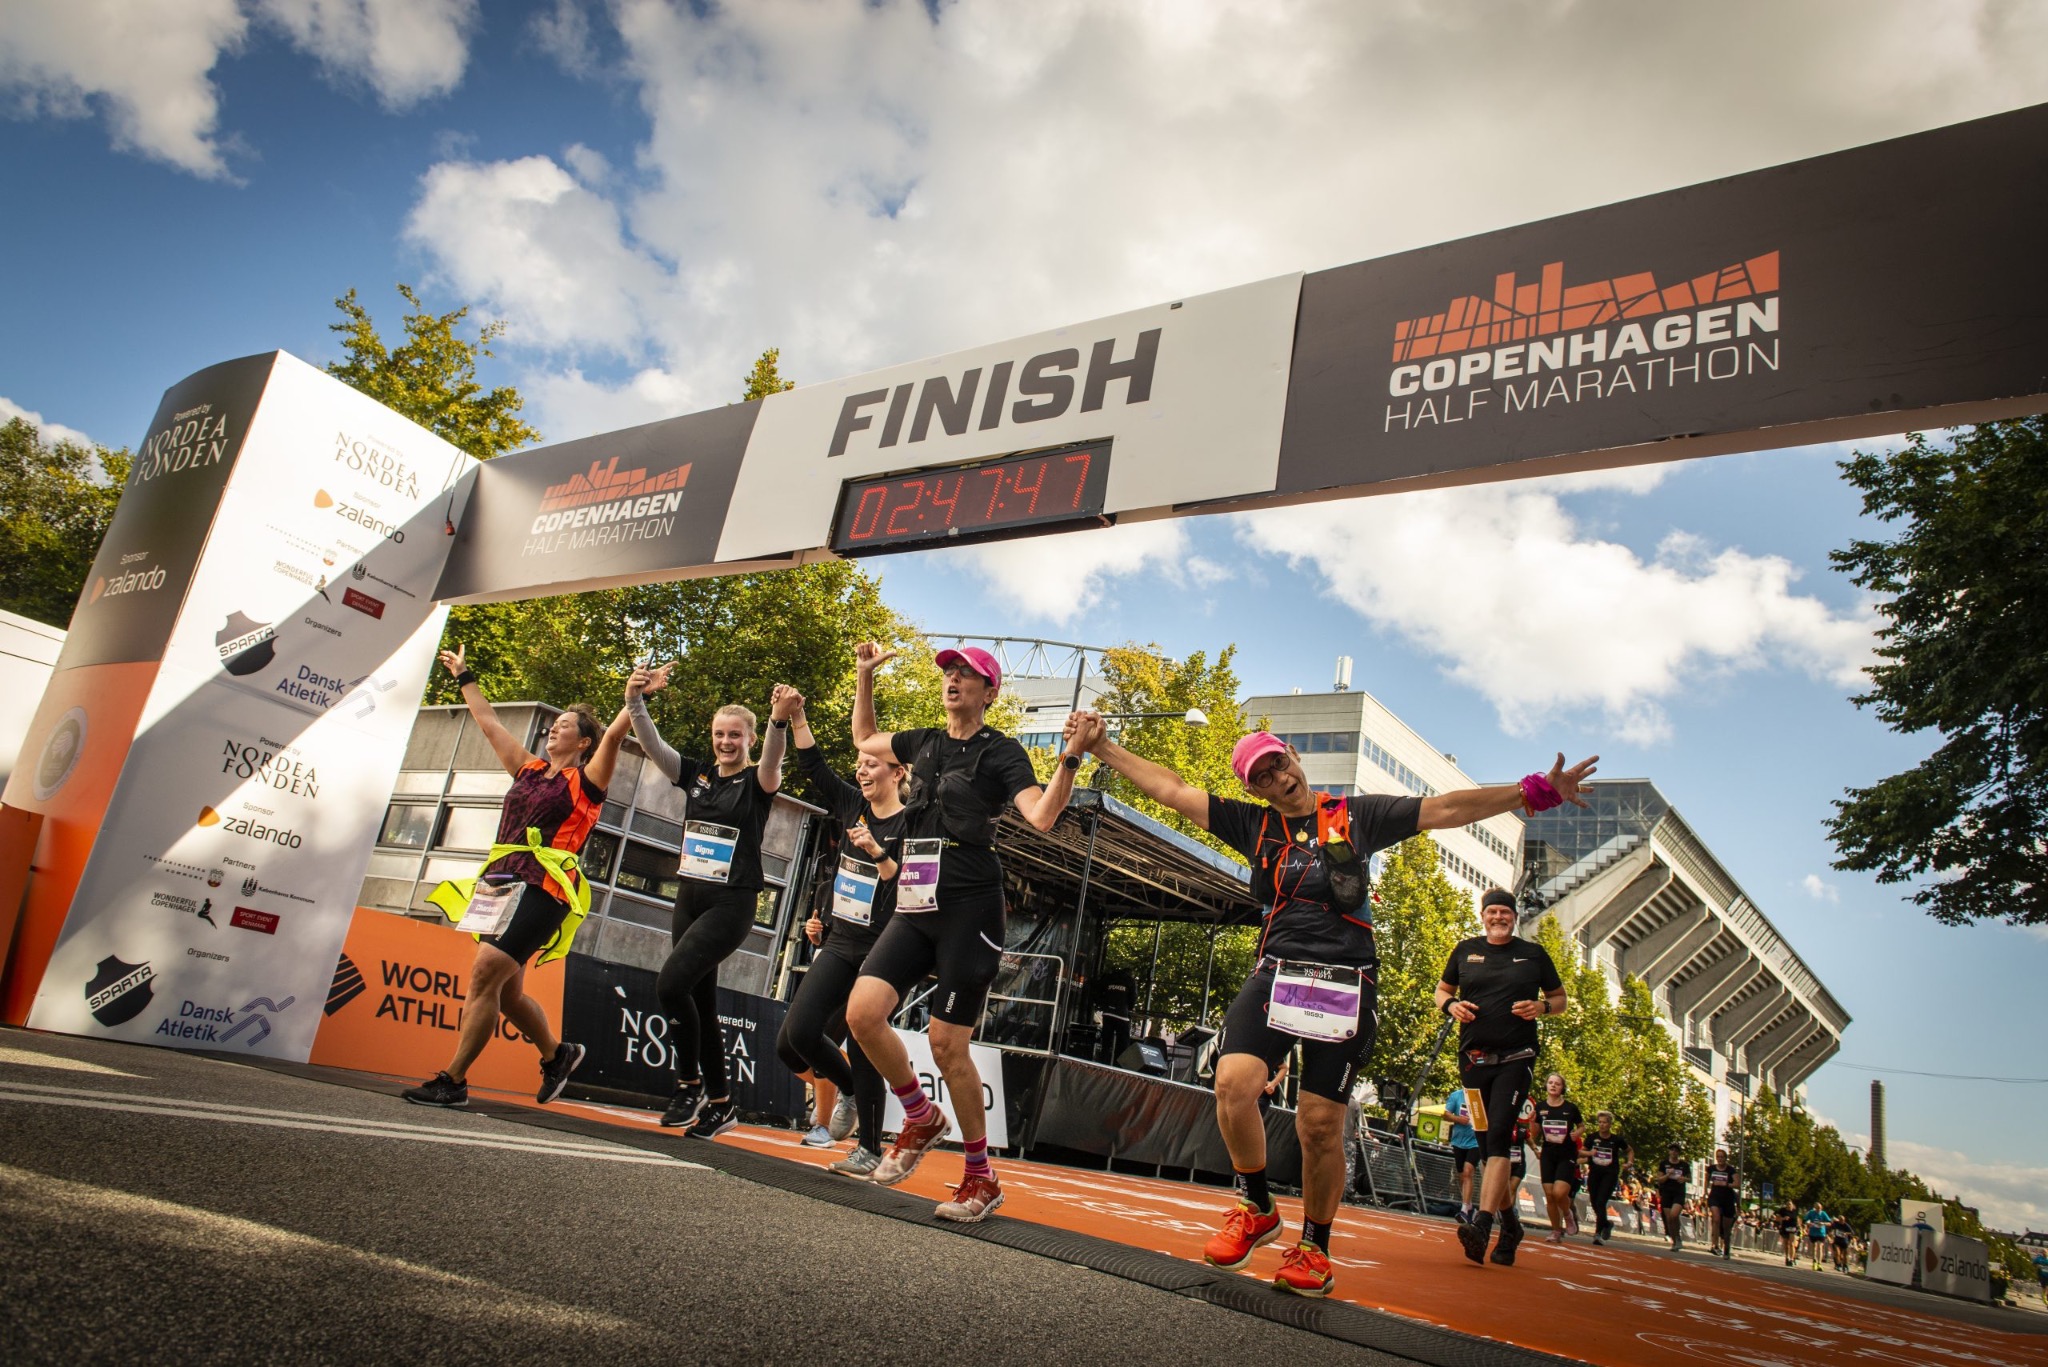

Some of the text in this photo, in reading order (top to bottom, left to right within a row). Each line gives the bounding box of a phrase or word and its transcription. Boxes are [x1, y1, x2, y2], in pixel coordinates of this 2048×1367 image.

[1389, 297, 1779, 397] COPENHAGEN
[827, 328, 1163, 458] FINISH
[1383, 338, 1780, 433] HALF MARATHON
[142, 413, 227, 461] NORDEA
[134, 439, 229, 487] FONDEN
[335, 431, 417, 485] NORDEA
[335, 448, 420, 501] FONDEN
[531, 491, 683, 535] COPENHAGEN
[849, 453, 1092, 542] 02:47:47
[336, 502, 405, 544] zalando
[521, 516, 675, 558] HALF MARATHON
[103, 564, 166, 597] zalando
[219, 626, 275, 657] SPARTA
[304, 617, 343, 638] Organizers
[276, 677, 331, 709] Atletik
[297, 664, 346, 695] Dansk
[260, 736, 291, 752] Powered
[222, 739, 317, 782] NORDEA
[221, 758, 320, 799] FONDEN
[242, 801, 275, 817] Sponsor
[223, 816, 302, 850] zalando
[222, 856, 257, 872] Partners
[694, 844, 716, 856] Signe
[150, 898, 197, 914] COPENHAGEN
[153, 891, 198, 908] WONDERFUL
[187, 947, 230, 963] Organizers
[90, 965, 152, 1010] SPARTA
[381, 959, 468, 1002] WORL
[179, 1000, 236, 1025] Dansk
[744, 1018, 757, 1032] by
[1303, 1010, 1324, 1019] 19593
[155, 1018, 220, 1042] Atletik
[1881, 1241, 1914, 1265] zalando
[1940, 1253, 1988, 1282] zalando
